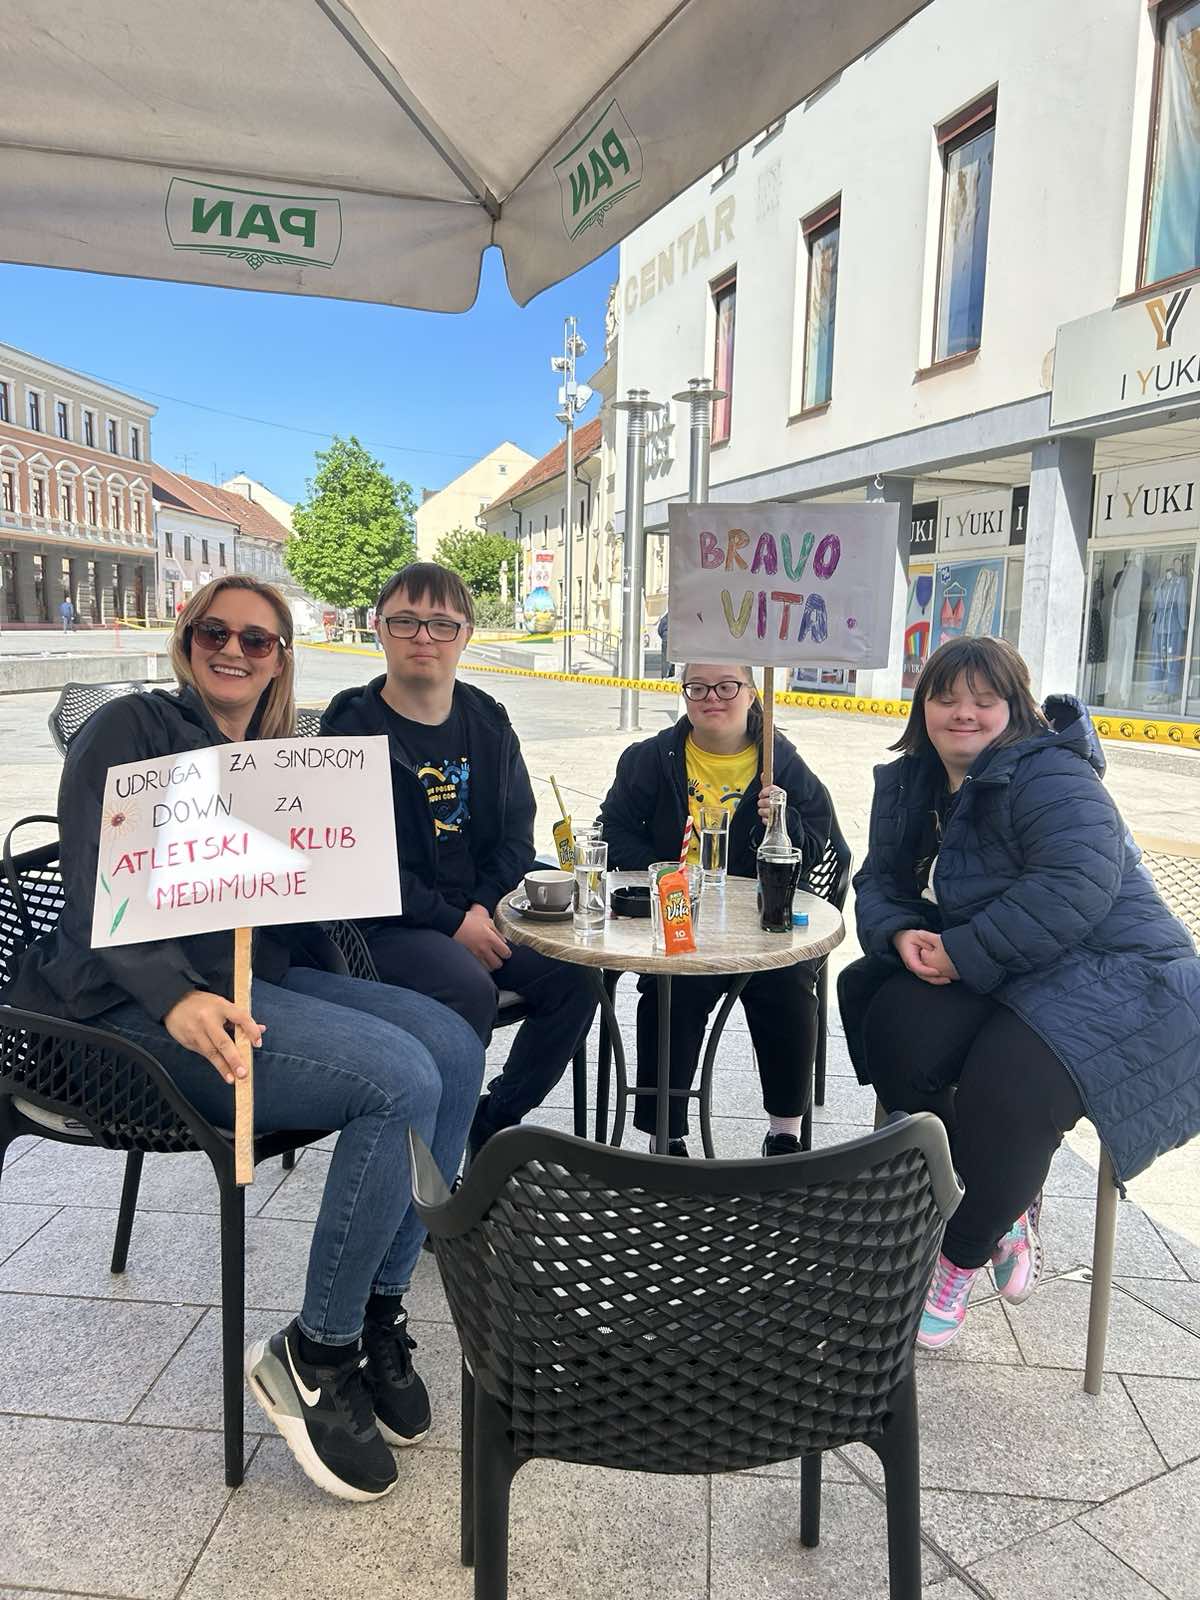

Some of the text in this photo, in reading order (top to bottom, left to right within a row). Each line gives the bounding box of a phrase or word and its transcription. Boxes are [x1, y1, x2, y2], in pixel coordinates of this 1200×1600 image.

[624, 194, 736, 315] CENTAR
[956, 509, 1005, 537] YUKI
[1122, 483, 1195, 518] YUKI
[699, 528, 841, 583] BRAVO
[720, 588, 828, 644] VITA
[115, 747, 365, 798] UDRUGA ZA SINDROM
[152, 793, 303, 828] DOWN ZA
[111, 826, 357, 877] ATLETSKI KLUB
[666, 898, 689, 921] Vita
